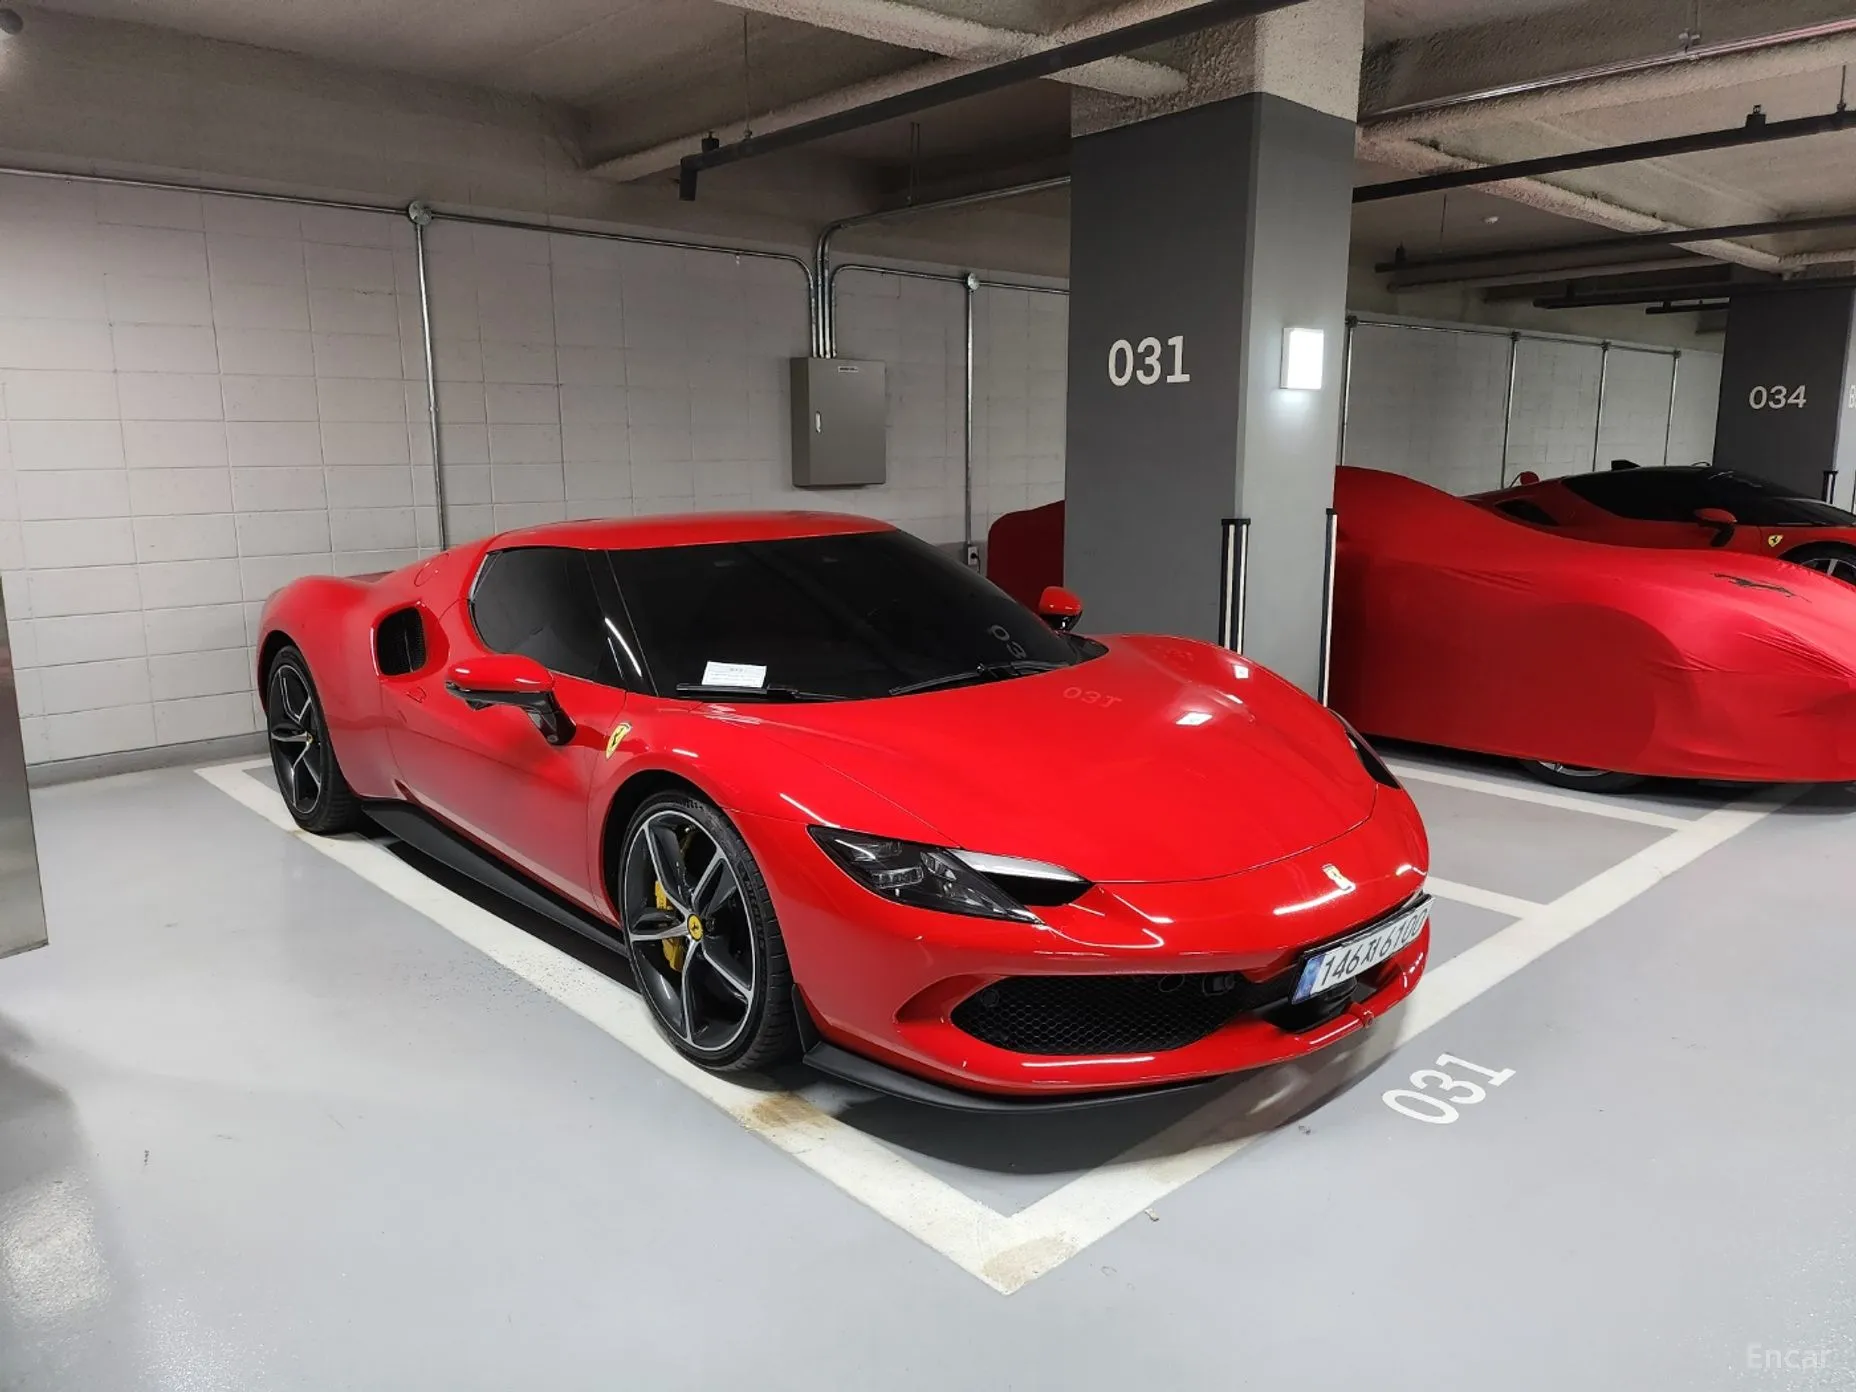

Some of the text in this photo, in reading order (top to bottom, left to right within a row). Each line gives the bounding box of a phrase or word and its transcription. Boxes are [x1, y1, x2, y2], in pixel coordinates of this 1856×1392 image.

[1108, 335, 1191, 386] 031
[1749, 385, 1806, 409] 034
[1382, 1054, 1516, 1124] 031
